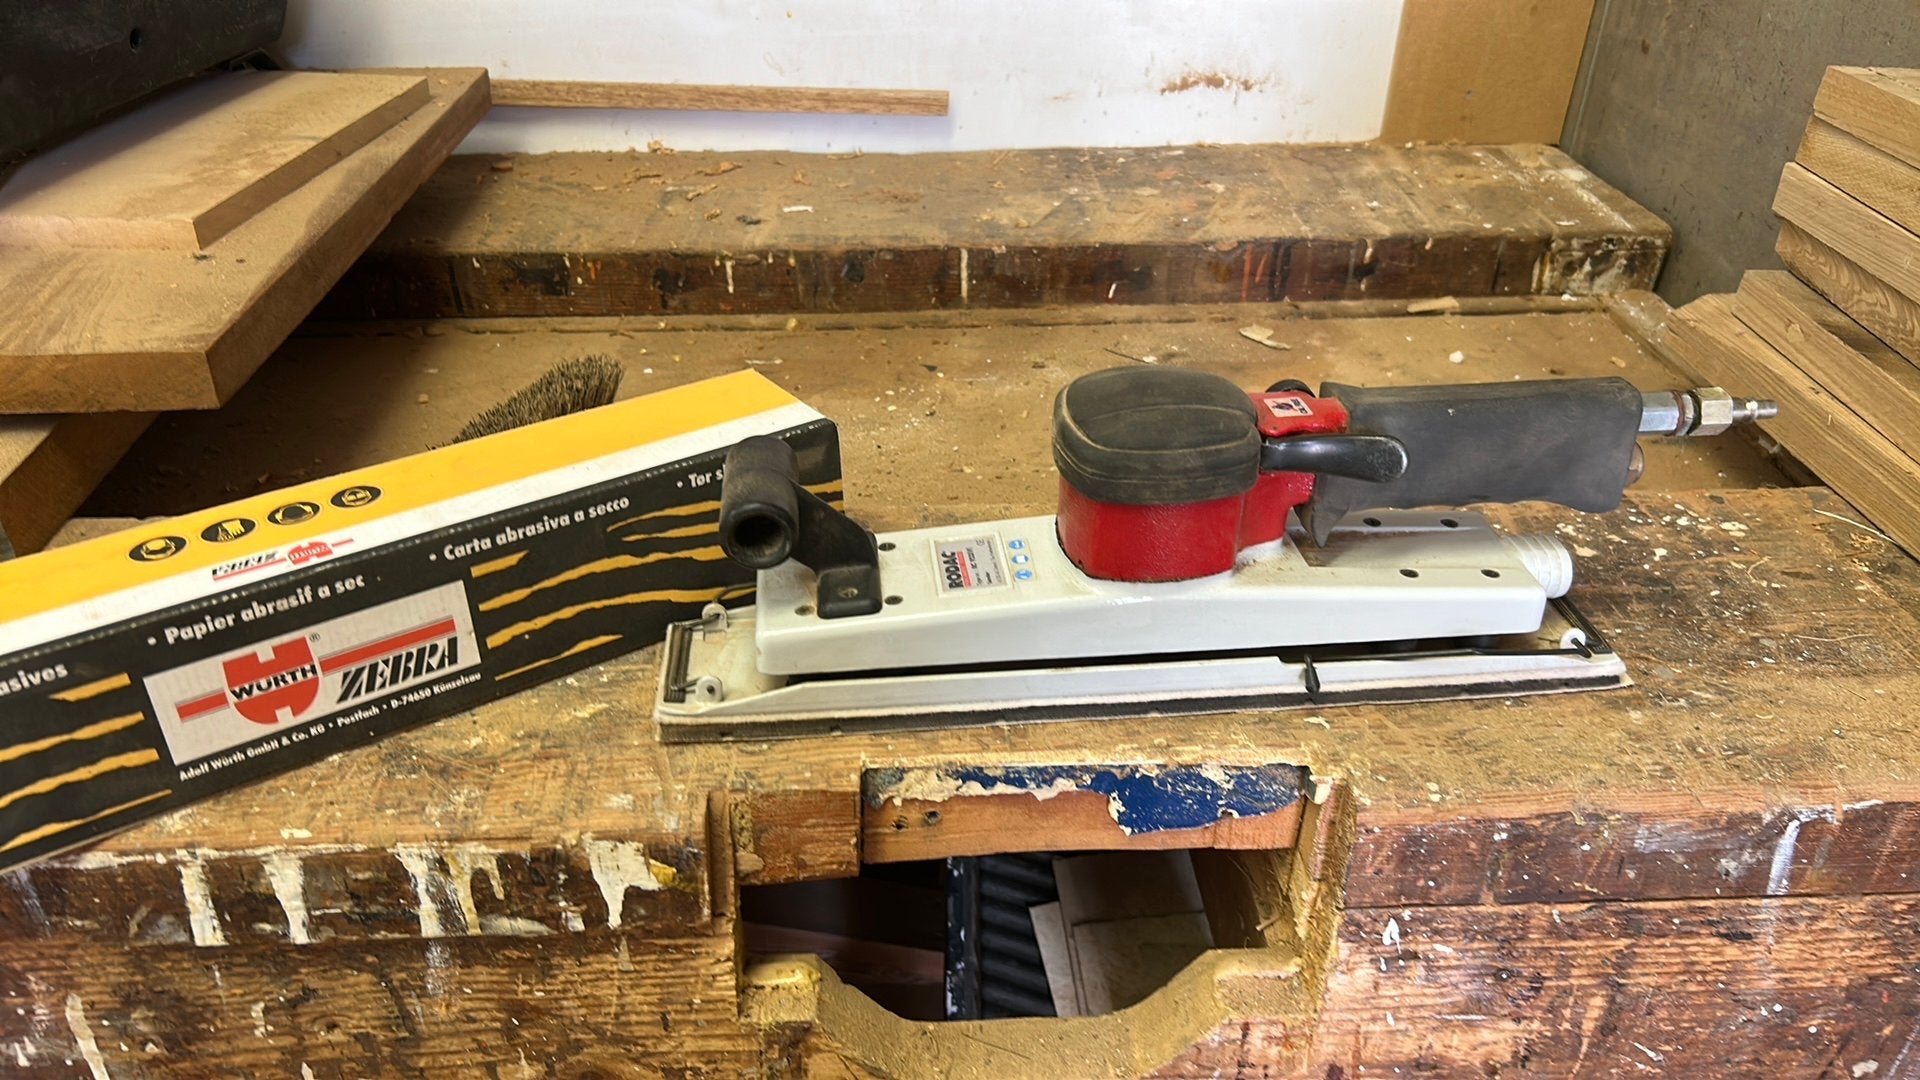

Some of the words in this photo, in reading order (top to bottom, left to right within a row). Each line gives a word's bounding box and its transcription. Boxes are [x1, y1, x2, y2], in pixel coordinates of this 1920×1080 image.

[444, 536, 492, 560] Carta
[496, 514, 570, 545] abrasiva
[574, 509, 585, 522] a
[589, 496, 630, 519] secco
[941, 551, 964, 589] RODAC
[164, 612, 236, 644] Papier
[241, 585, 314, 622] abrasif
[335, 574, 366, 594] sec
[336, 636, 458, 704] ZEBRA
[179, 762, 210, 782] Adolf
[247, 739, 280, 758] GmbH
[281, 736, 291, 747] &
[291, 731, 309, 742] Co.
[309, 723, 326, 737] KG
[336, 705, 380, 728] Postfach
[390, 687, 432, 709] D-74650
